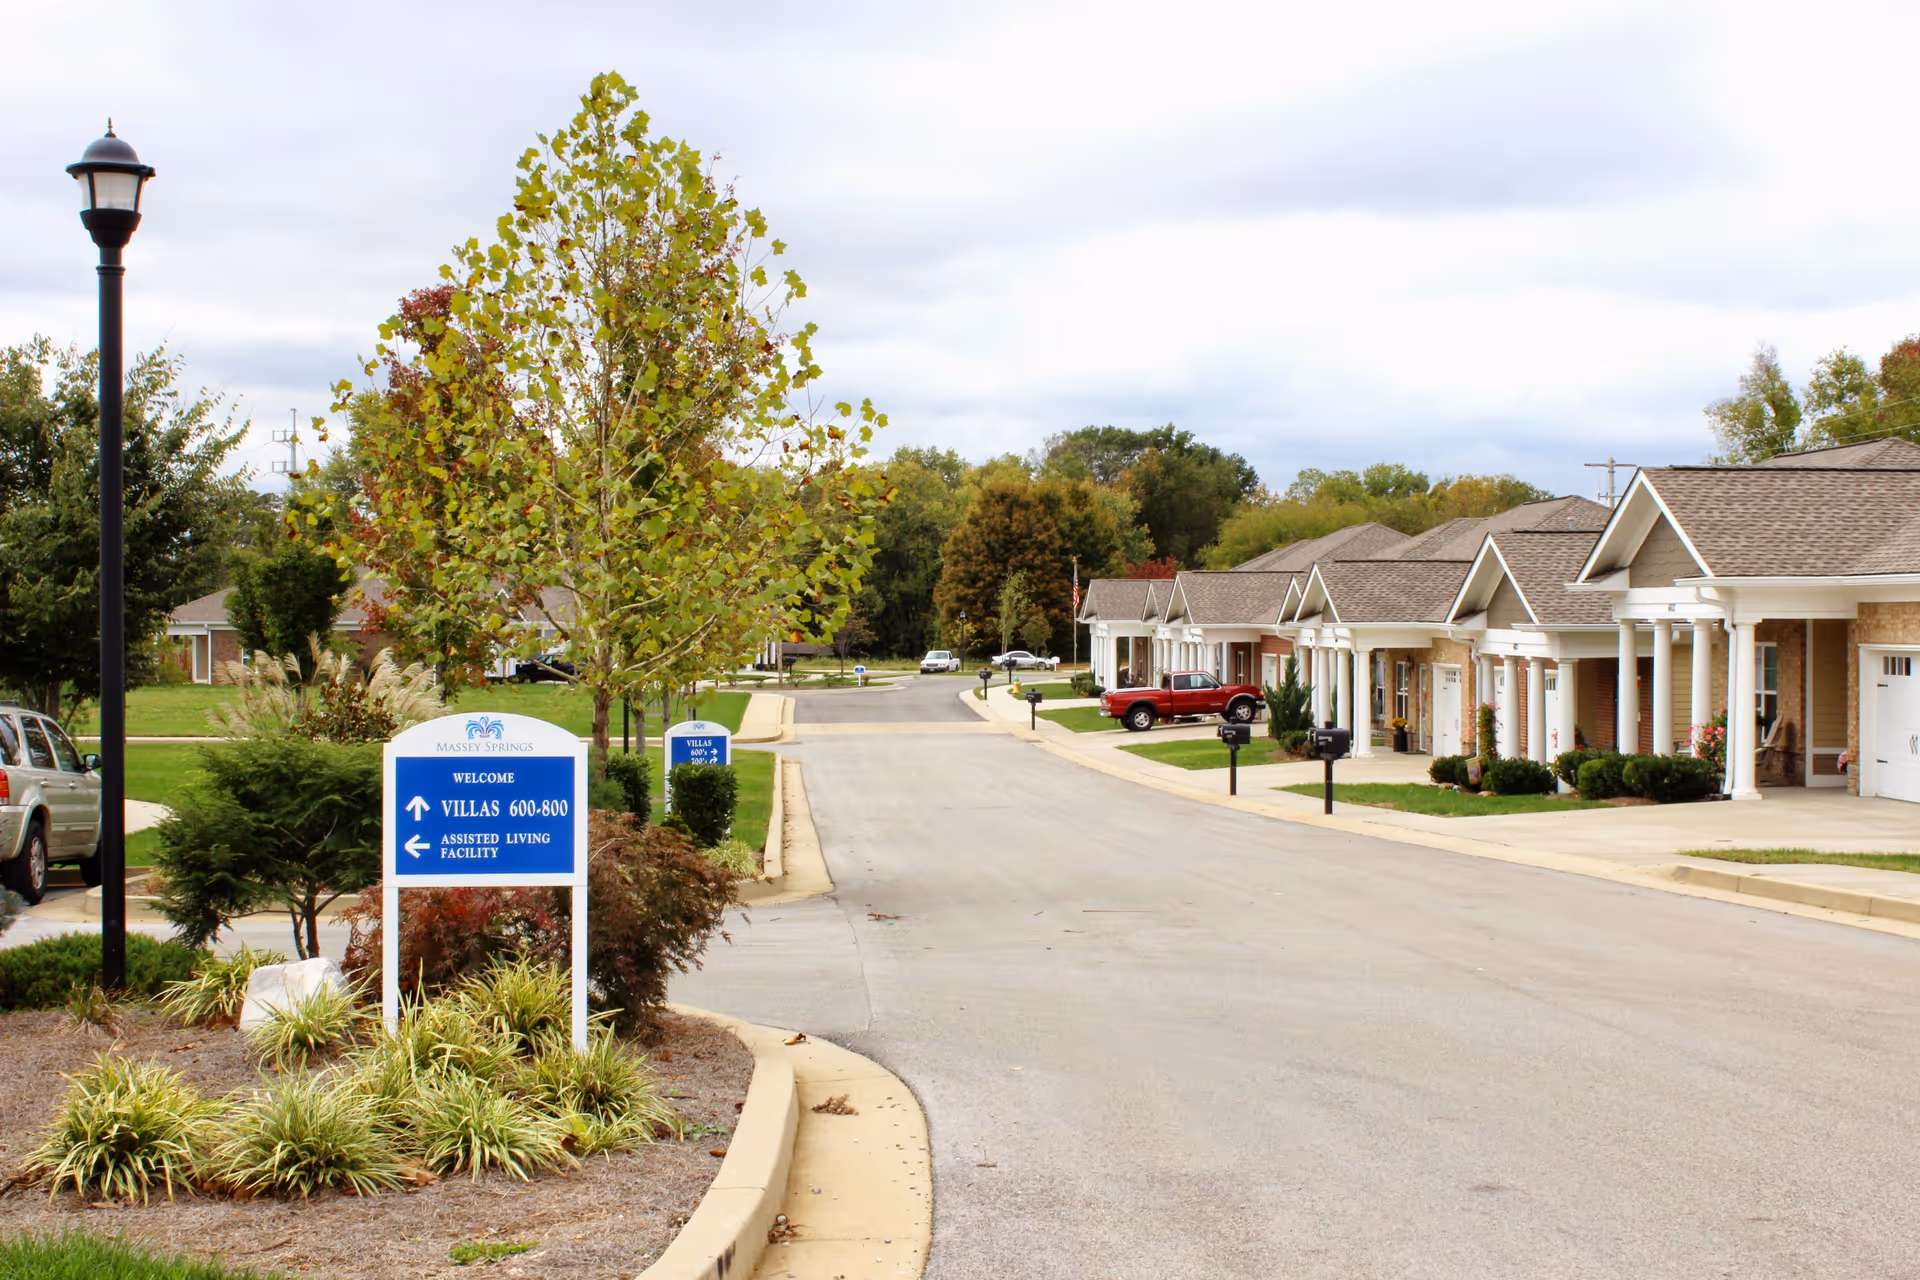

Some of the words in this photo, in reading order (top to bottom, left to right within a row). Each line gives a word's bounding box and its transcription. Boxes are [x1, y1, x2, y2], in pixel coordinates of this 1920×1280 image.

[436, 742, 481, 752] MASSEY
[485, 742, 534, 752] SPRINGS
[686, 739, 713, 747] VILLAS
[453, 772, 515, 784] WELCOME
[440, 799, 500, 817] VILLAS
[509, 799, 568, 817] 600-800
[440, 833, 500, 845] ASSISTED
[506, 832, 551, 845] LIVING
[440, 847, 499, 859] FACILITY
